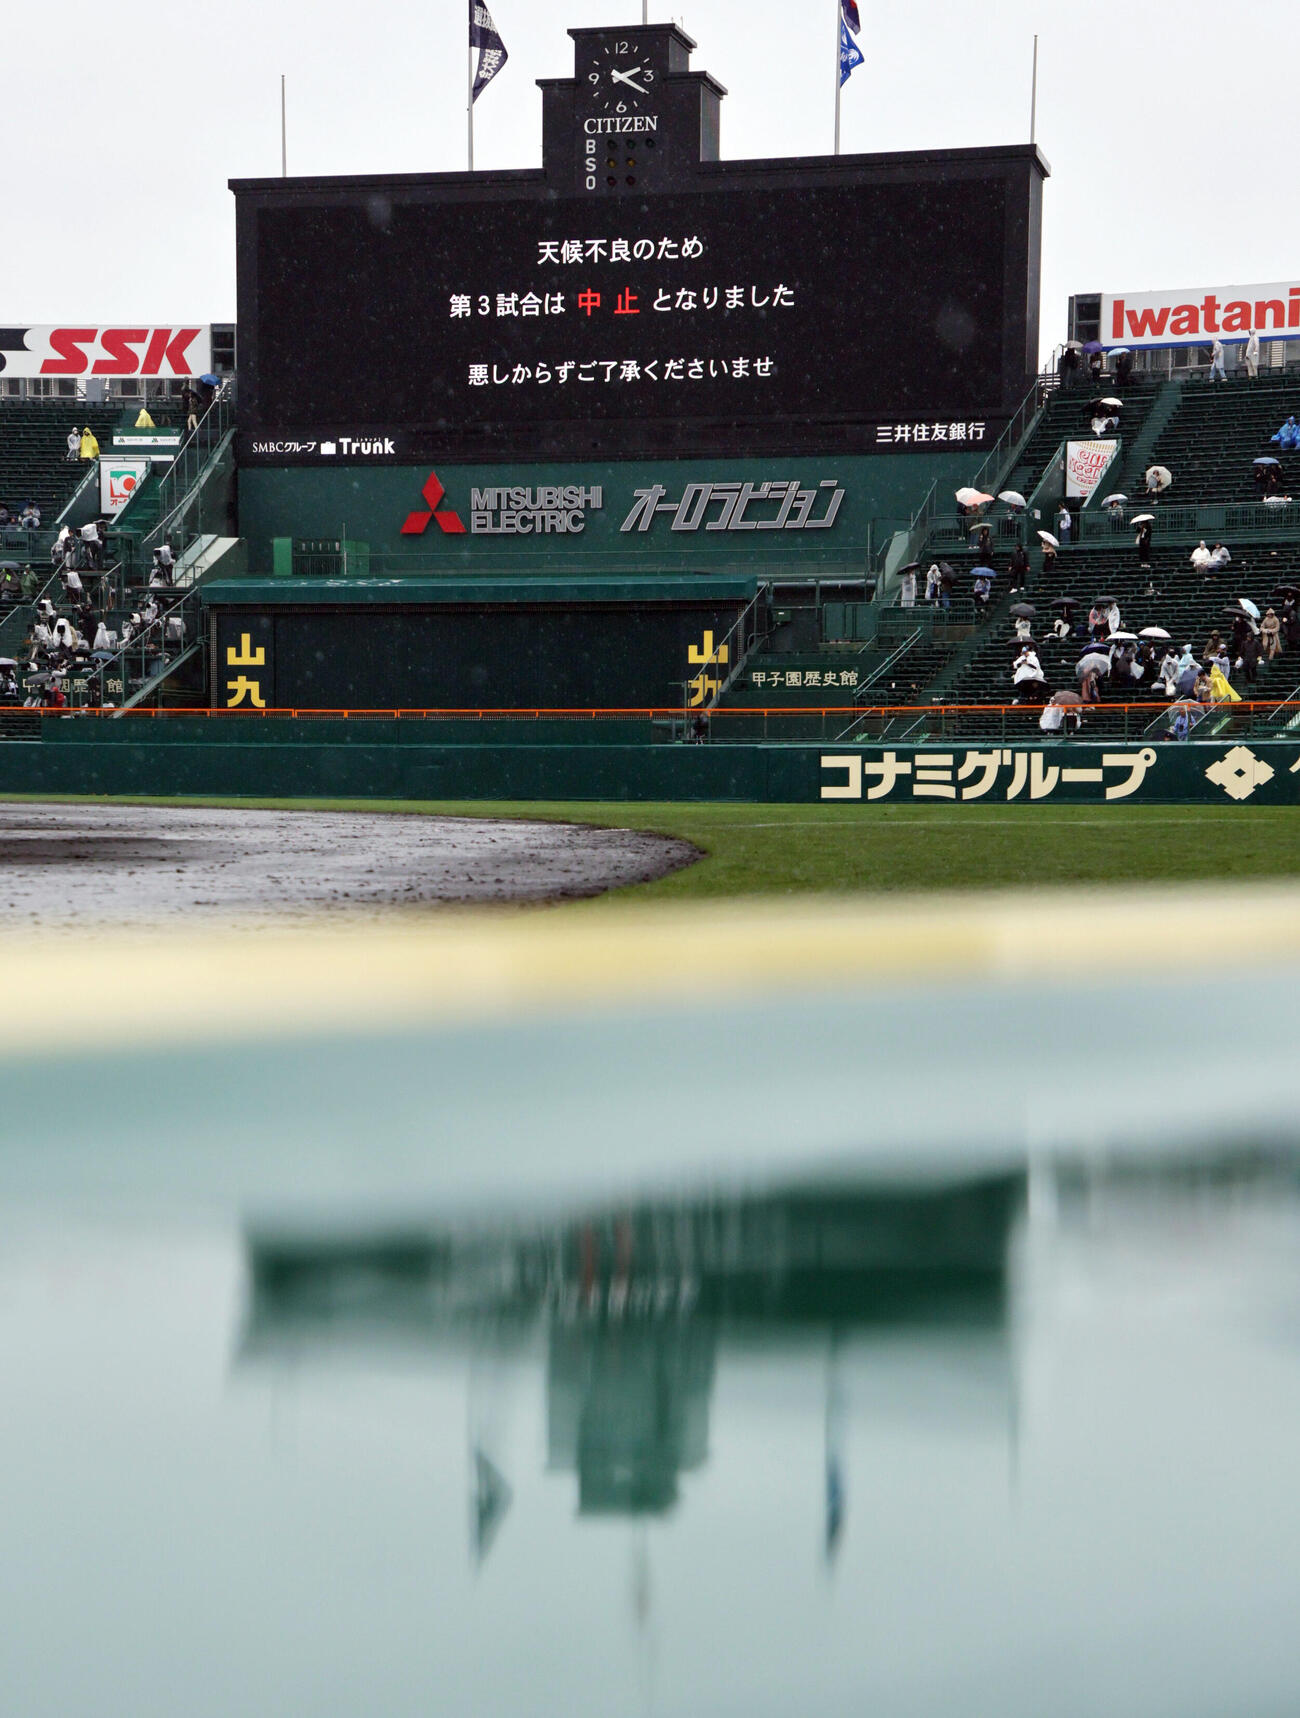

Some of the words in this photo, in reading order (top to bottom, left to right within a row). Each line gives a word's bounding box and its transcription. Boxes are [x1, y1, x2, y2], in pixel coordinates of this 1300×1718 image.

[615, 41, 629, 54] 12
[588, 72, 600, 85] 9
[643, 69, 654, 82] 3
[615, 100, 627, 113] 6
[583, 115, 659, 134] CITIZEN
[585, 139, 596, 154] B
[585, 157, 597, 172] S
[536, 235, 704, 265] 天候不良のため
[1112, 287, 1300, 339] Iwatani
[39, 328, 201, 375] SSK
[468, 356, 774, 386] 悪しからずご了承くださいませ
[875, 422, 986, 443] 三井住友銀行
[252, 441, 317, 453] SMBCグループ
[338, 437, 396, 455] Trunk
[470, 486, 603, 511] MITSUBISHI
[619, 479, 846, 532] オーロラビジョン
[470, 510, 585, 534] ELECTRIC
[226, 633, 266, 708] 山九
[752, 670, 859, 688] 甲子園歴史館
[820, 747, 1158, 801] コナミグループ
